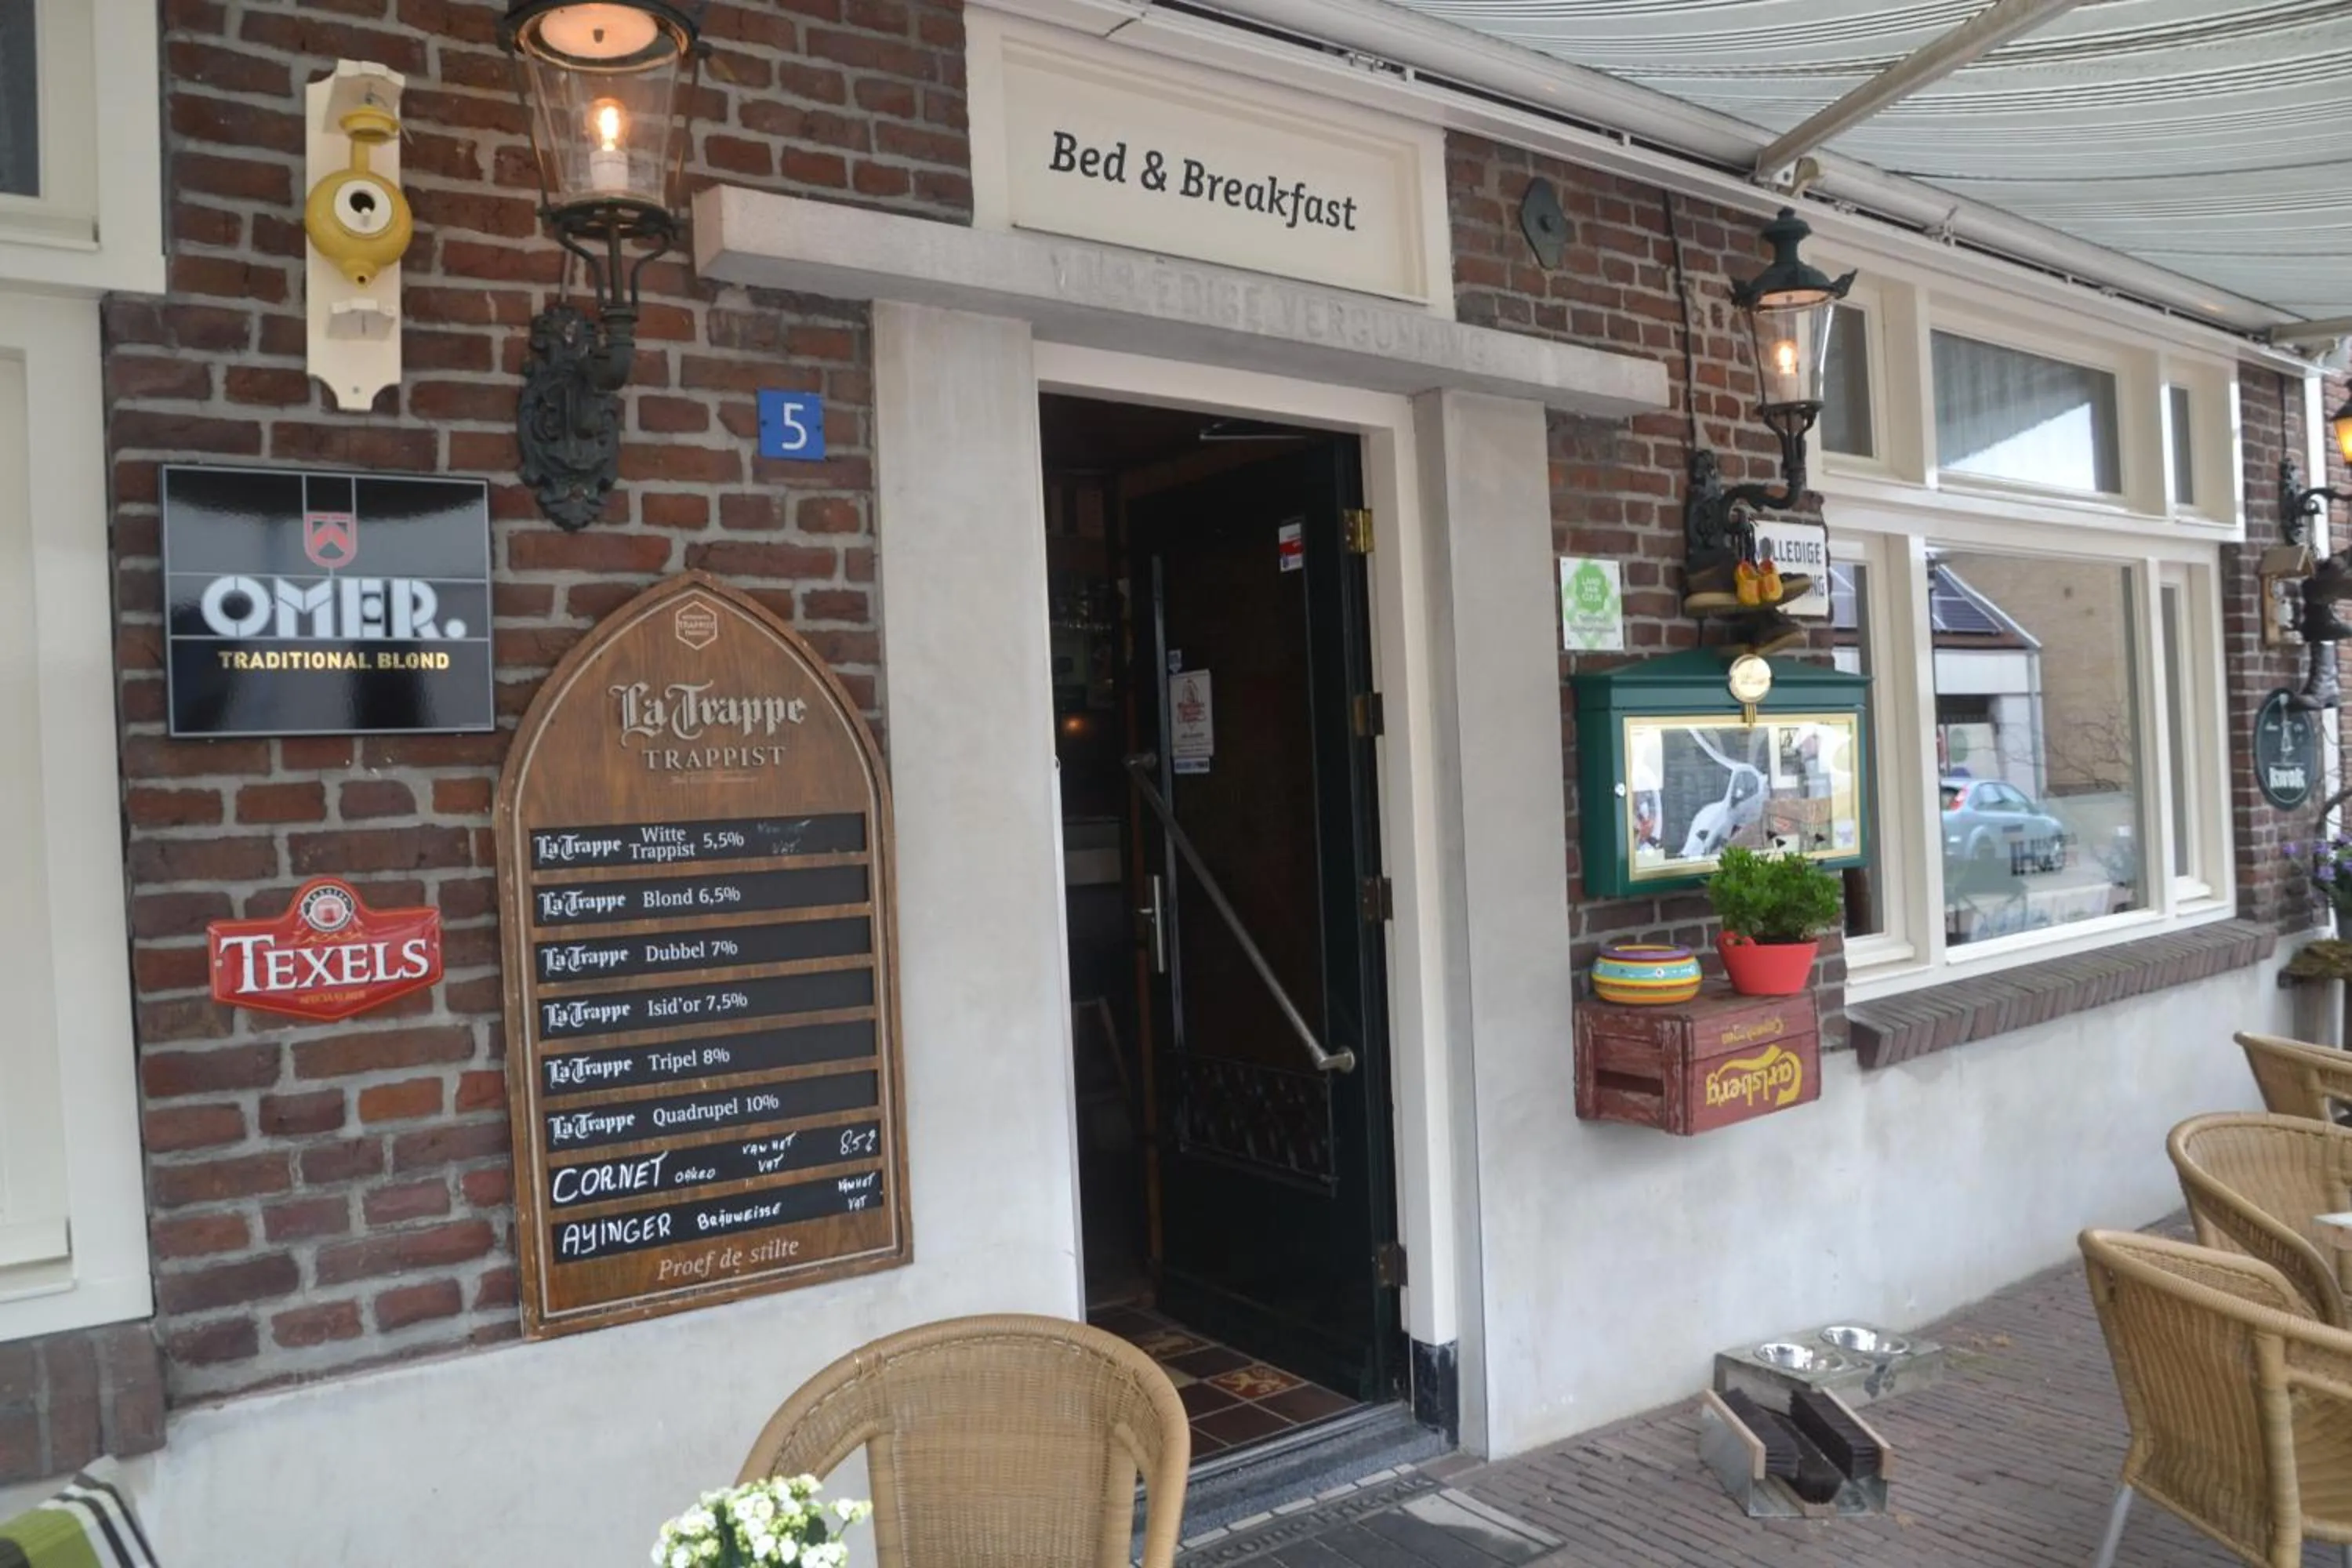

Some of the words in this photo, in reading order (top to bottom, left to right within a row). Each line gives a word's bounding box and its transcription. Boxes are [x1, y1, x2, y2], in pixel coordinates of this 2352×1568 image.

[1048, 130, 1127, 183] Bed
[1140, 149, 1167, 192] &
[1179, 158, 1358, 231] Breakfast
[781, 401, 808, 451] 5
[217, 650, 372, 670] TRADITIONAL
[377, 652, 451, 670] BLOND
[642, 746, 787, 771] TRAPPIST
[641, 826, 687, 844] Witte
[703, 831, 746, 850] 5,5%
[629, 842, 695, 862] Trappist
[642, 887, 694, 909] Blond
[699, 886, 742, 906] 6,5%
[219, 933, 430, 994] TEXELS
[645, 940, 705, 963] Dubbel
[711, 939, 739, 957] 7%
[647, 996, 702, 1018] Isid'or
[706, 992, 749, 1012] 7,5%
[648, 1049, 697, 1073] Tripel
[703, 1047, 731, 1065] 8%
[1706, 1044, 1802, 1107] Carlsberg
[653, 1097, 739, 1127] Quadrupel
[746, 1093, 780, 1113] 10%
[552, 1149, 670, 1203] CORNET
[561, 1212, 672, 1254] AYINGER
[657, 1248, 717, 1282] Proef
[720, 1247, 744, 1269] de
[750, 1237, 800, 1265] stilte
